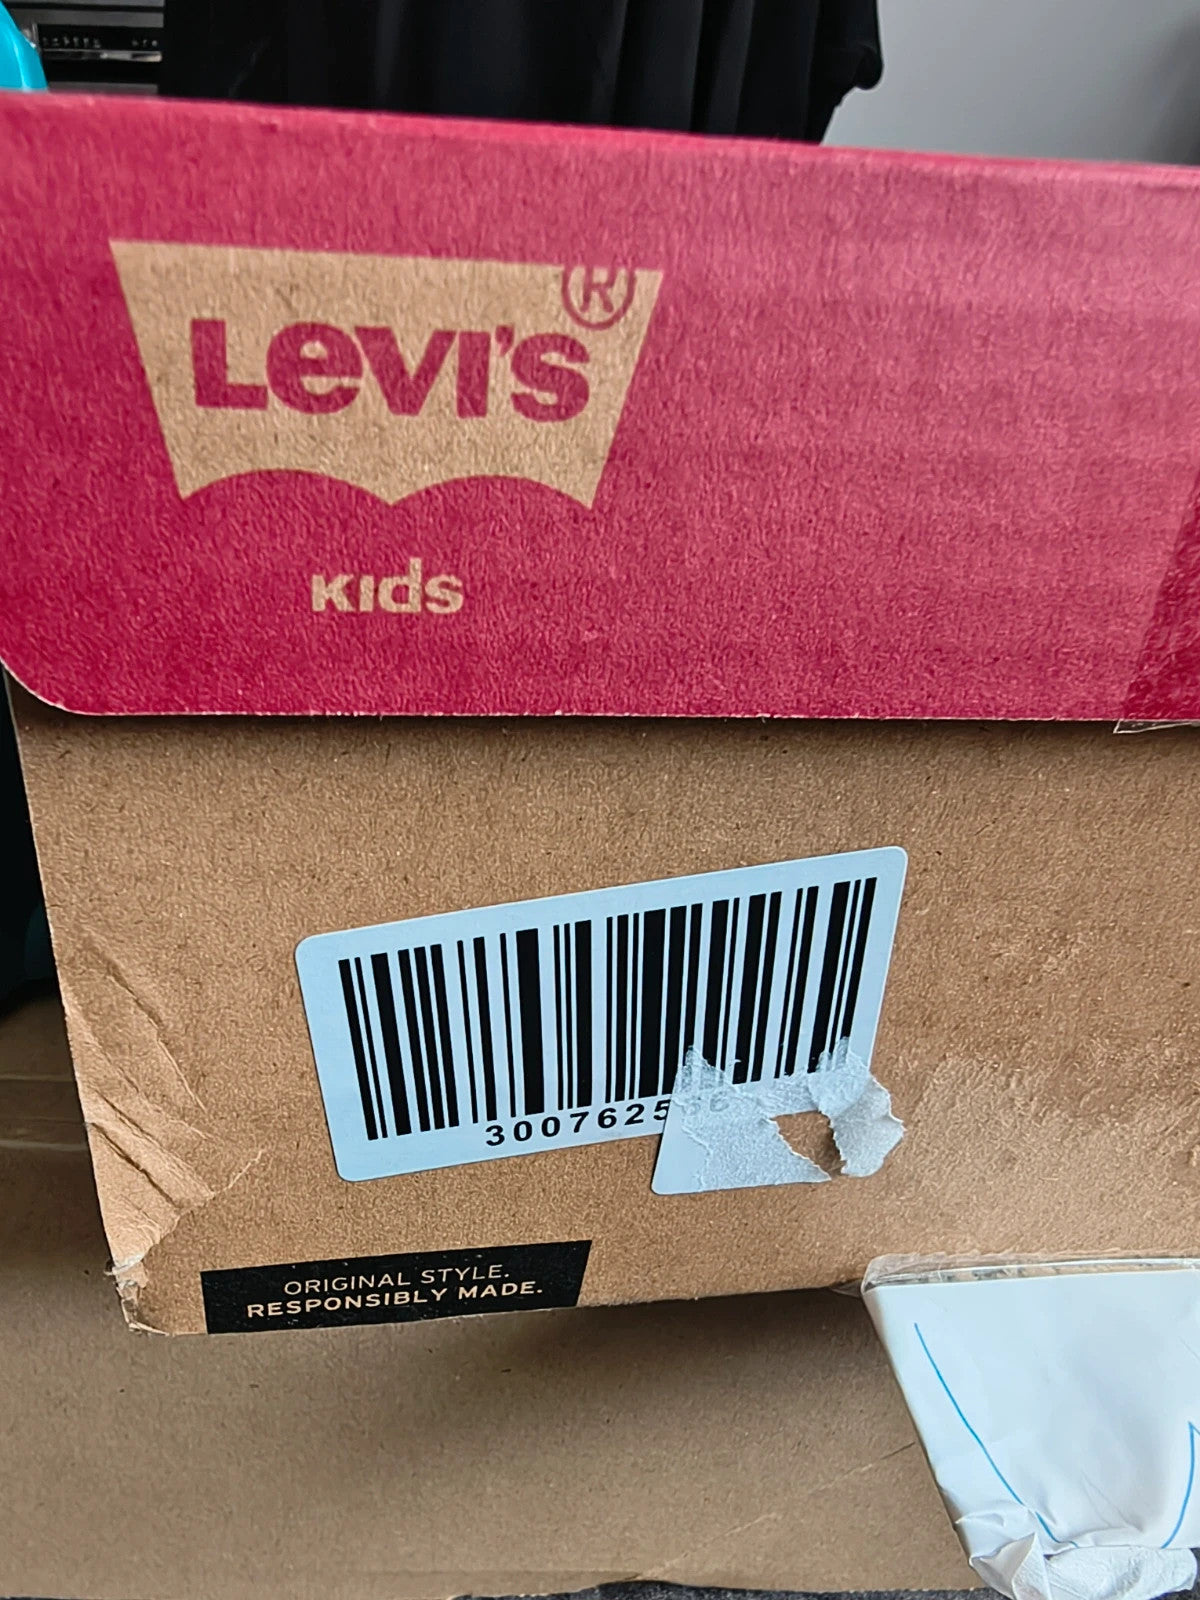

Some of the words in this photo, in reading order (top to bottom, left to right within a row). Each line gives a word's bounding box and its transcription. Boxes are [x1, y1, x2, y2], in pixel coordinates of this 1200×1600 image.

[283, 1271, 411, 1296] ORIGINAL
[420, 1263, 510, 1285] STYLE.
[246, 1288, 453, 1319] RESPONSIBLY
[457, 1280, 543, 1300] MADE.
